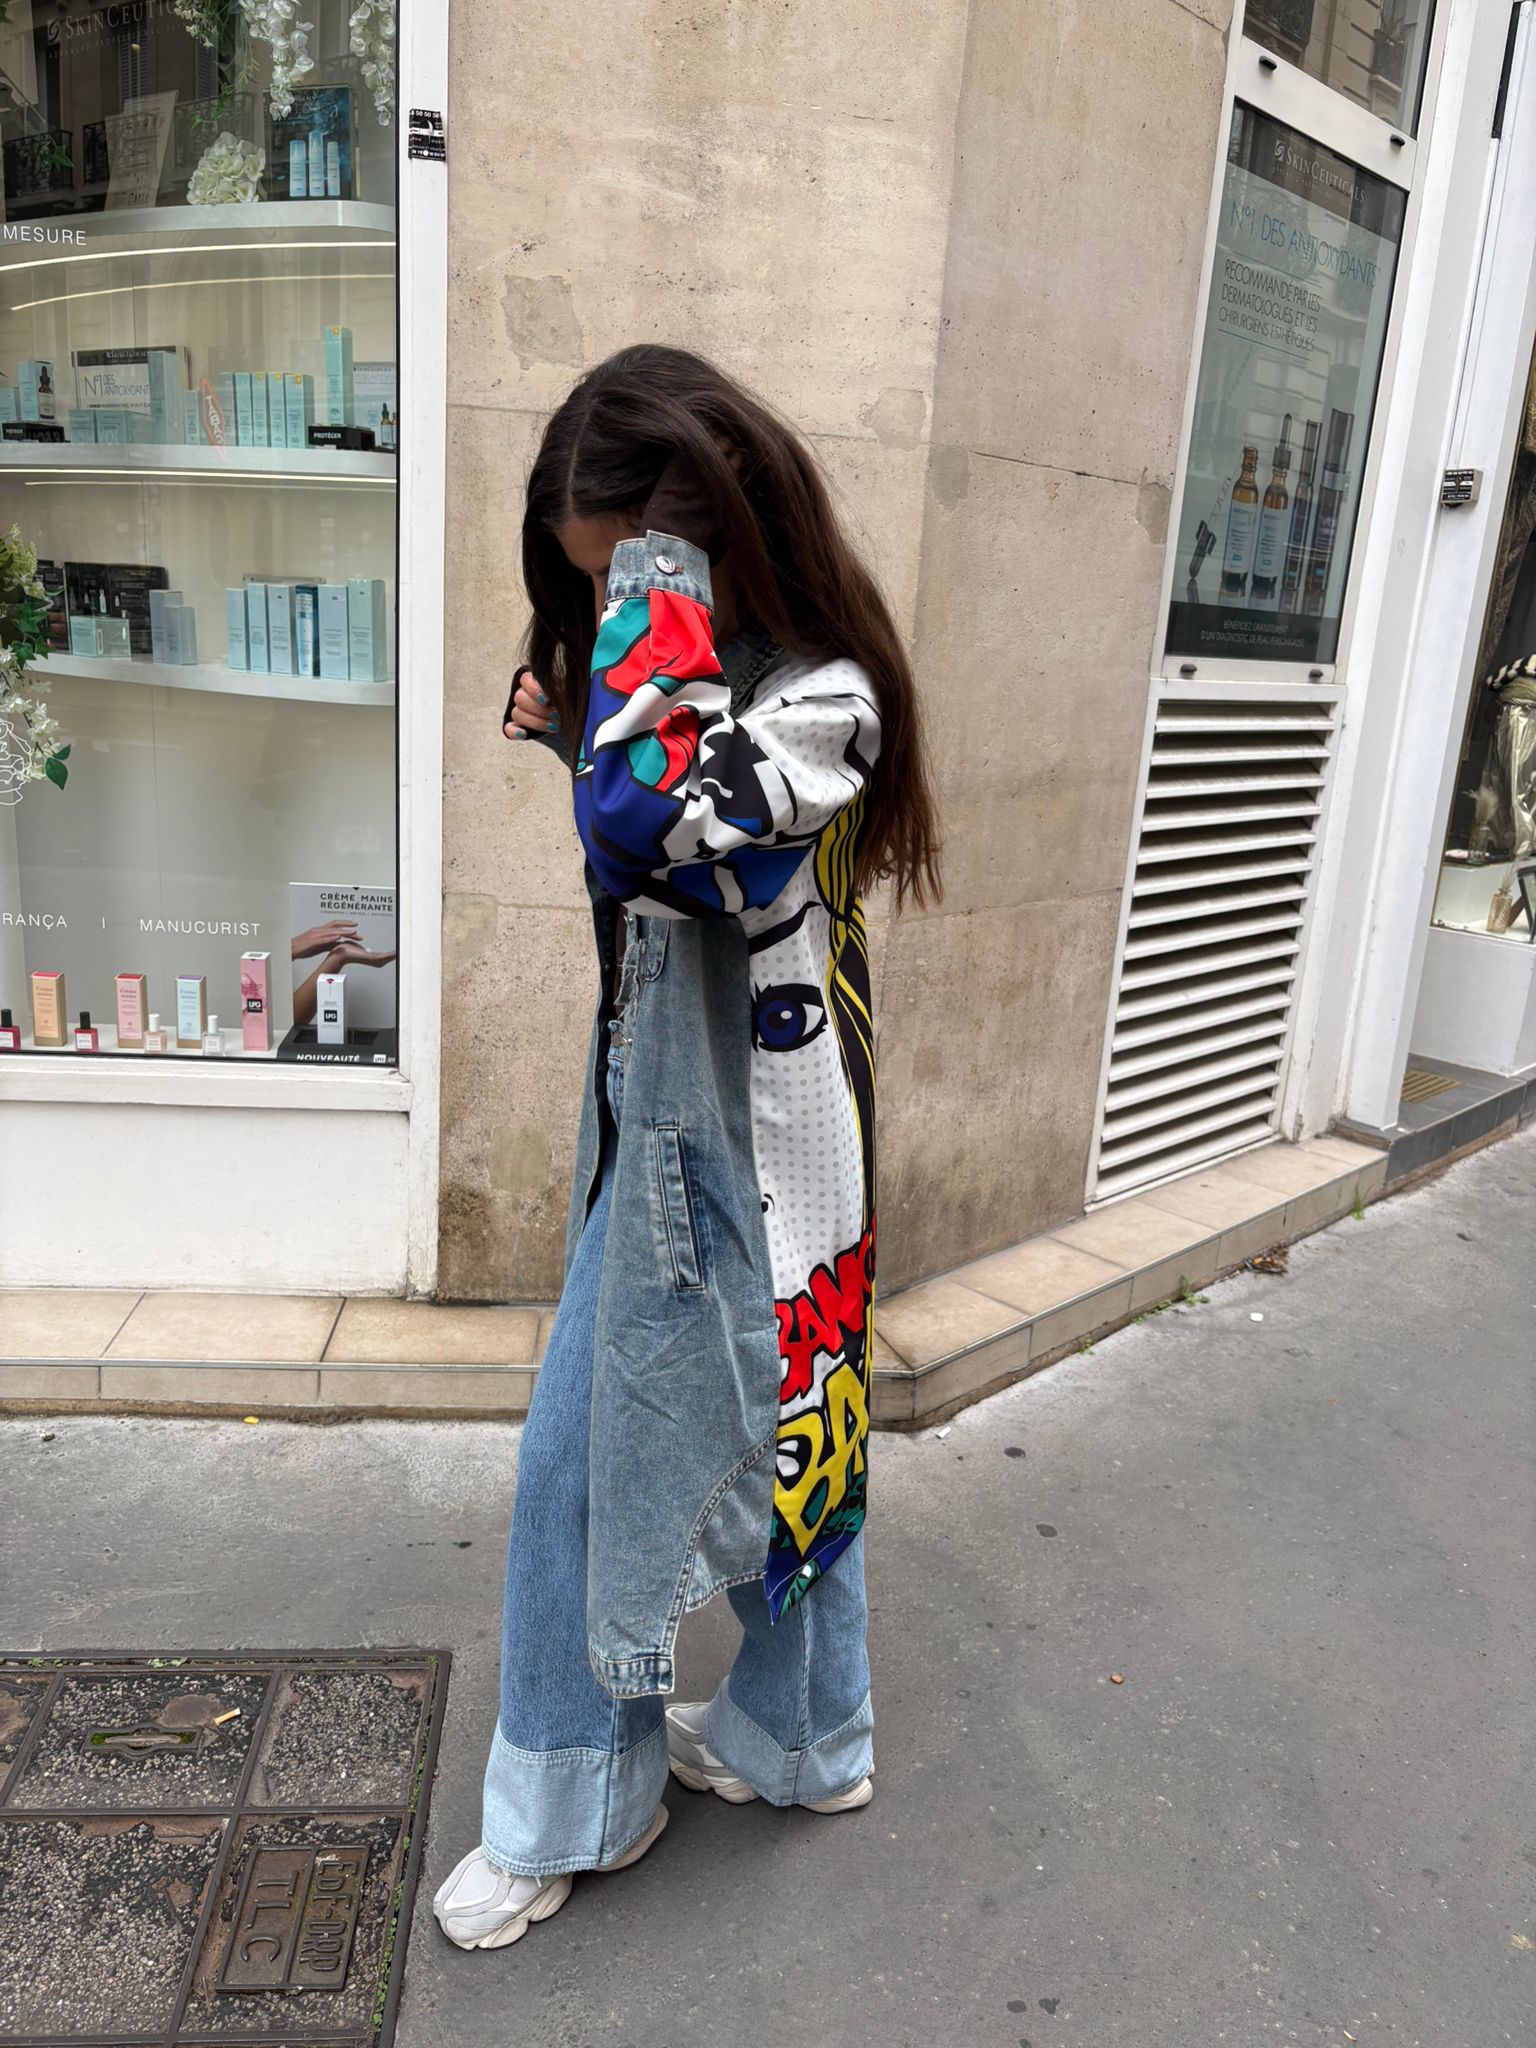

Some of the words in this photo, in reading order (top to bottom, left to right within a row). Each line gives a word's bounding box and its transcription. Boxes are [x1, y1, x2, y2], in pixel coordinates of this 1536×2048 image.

[3, 224, 87, 246] MESURE
[1261, 214, 1286, 248] DES
[1225, 258, 1294, 302] RECOMMANDÉ
[1293, 286, 1308, 307] PAR
[1307, 293, 1320, 312] LES
[1221, 283, 1293, 324] DERMATOLOGUES
[1295, 310, 1304, 327] ET
[1305, 315, 1318, 333] LES
[1219, 306, 1269, 336] CHIRURGIENS
[313, 431, 342, 439] PROTÉGER
[320, 892, 355, 902] CRÈME
[361, 895, 393, 904] MAINS
[320, 901, 393, 912] RÉGÉNÉRANTE
[2, 912, 68, 930] RANÇA
[140, 919, 260, 935] MANUCURIST
[296, 1053, 361, 1063] NOUVEAUTÉ
[239, 1868, 300, 1963] TLC
